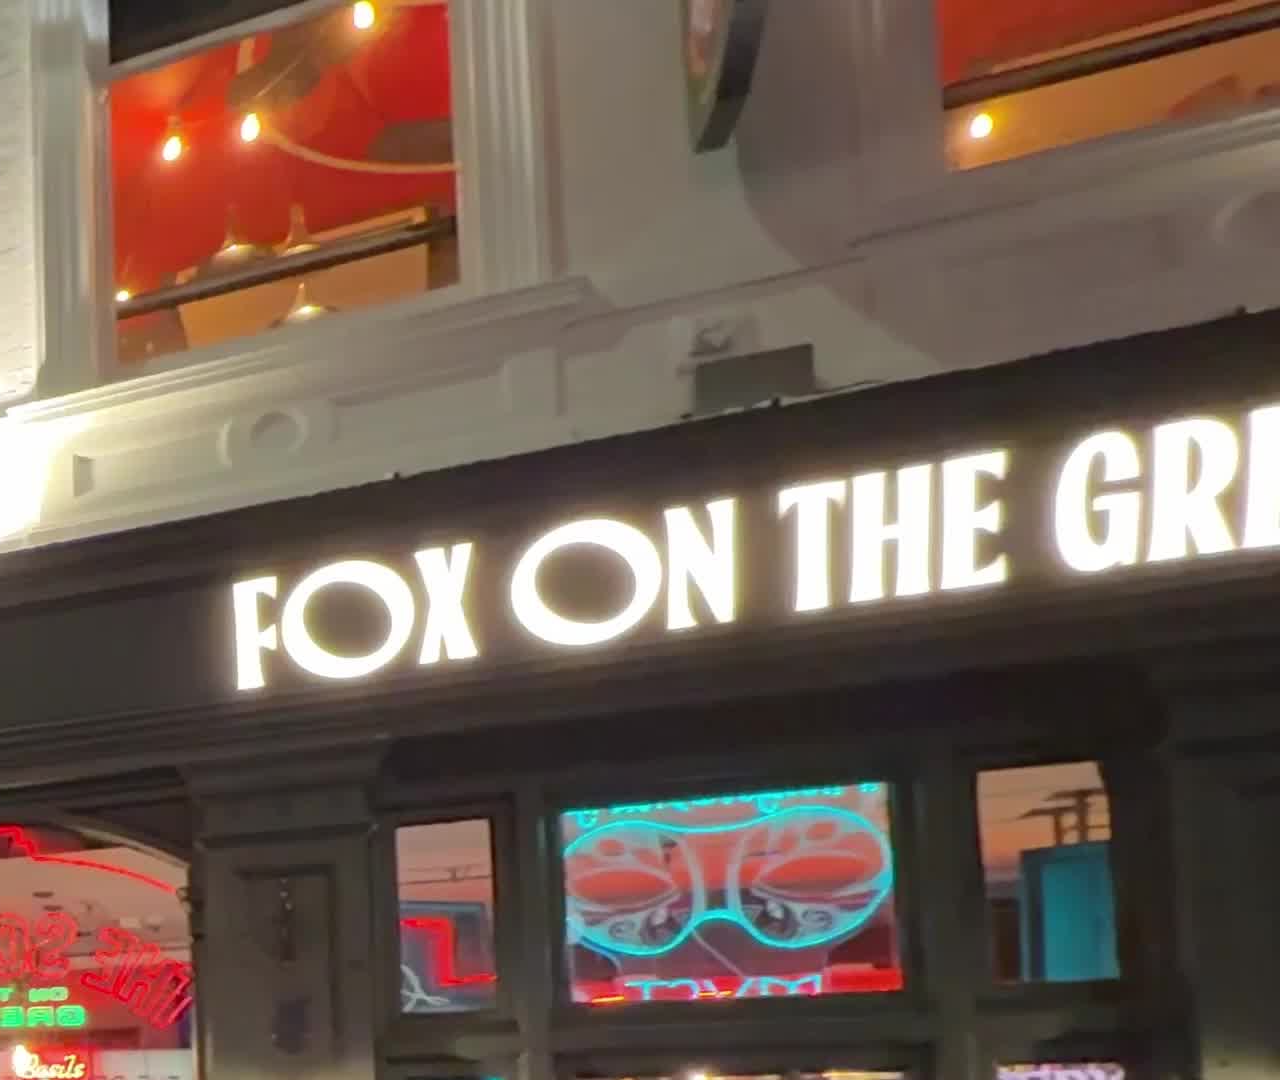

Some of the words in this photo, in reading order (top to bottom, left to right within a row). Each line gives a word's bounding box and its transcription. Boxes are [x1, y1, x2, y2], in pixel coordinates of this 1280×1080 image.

[232, 542, 478, 690] FOX
[510, 496, 736, 646] ON
[778, 448, 1008, 612] THE
